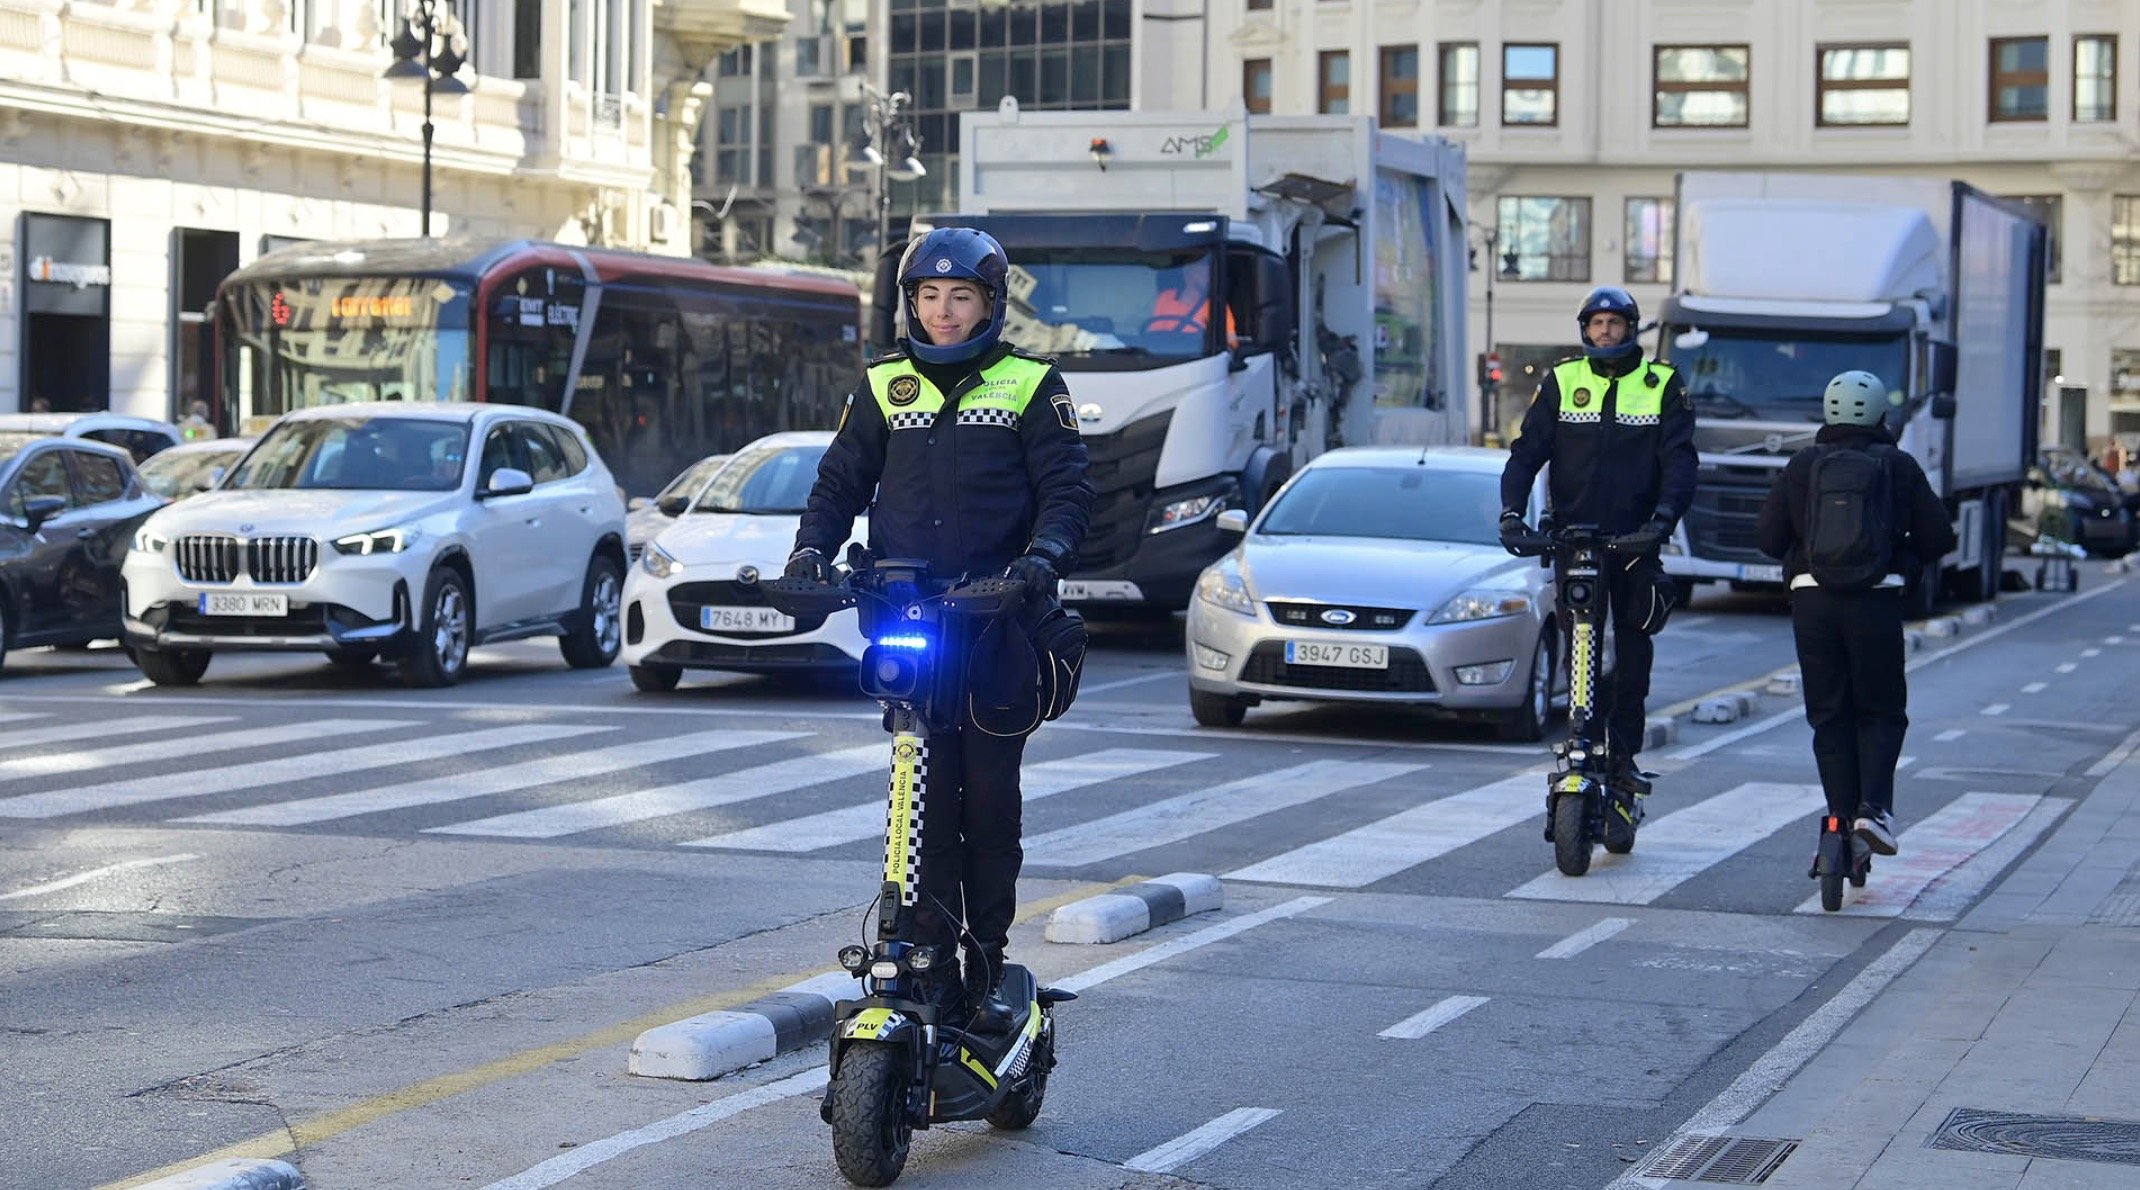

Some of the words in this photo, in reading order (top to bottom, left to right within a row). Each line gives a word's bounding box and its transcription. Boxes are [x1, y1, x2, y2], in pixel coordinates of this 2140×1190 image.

[1161, 135, 1212, 154] AMS
[984, 379, 1017, 387] OLICIA
[252, 596, 280, 611] MRN
[713, 611, 753, 627] 7648
[1298, 645, 1342, 663] 3947
[1349, 647, 1384, 665] GSJ
[895, 813, 904, 839] LOCAL
